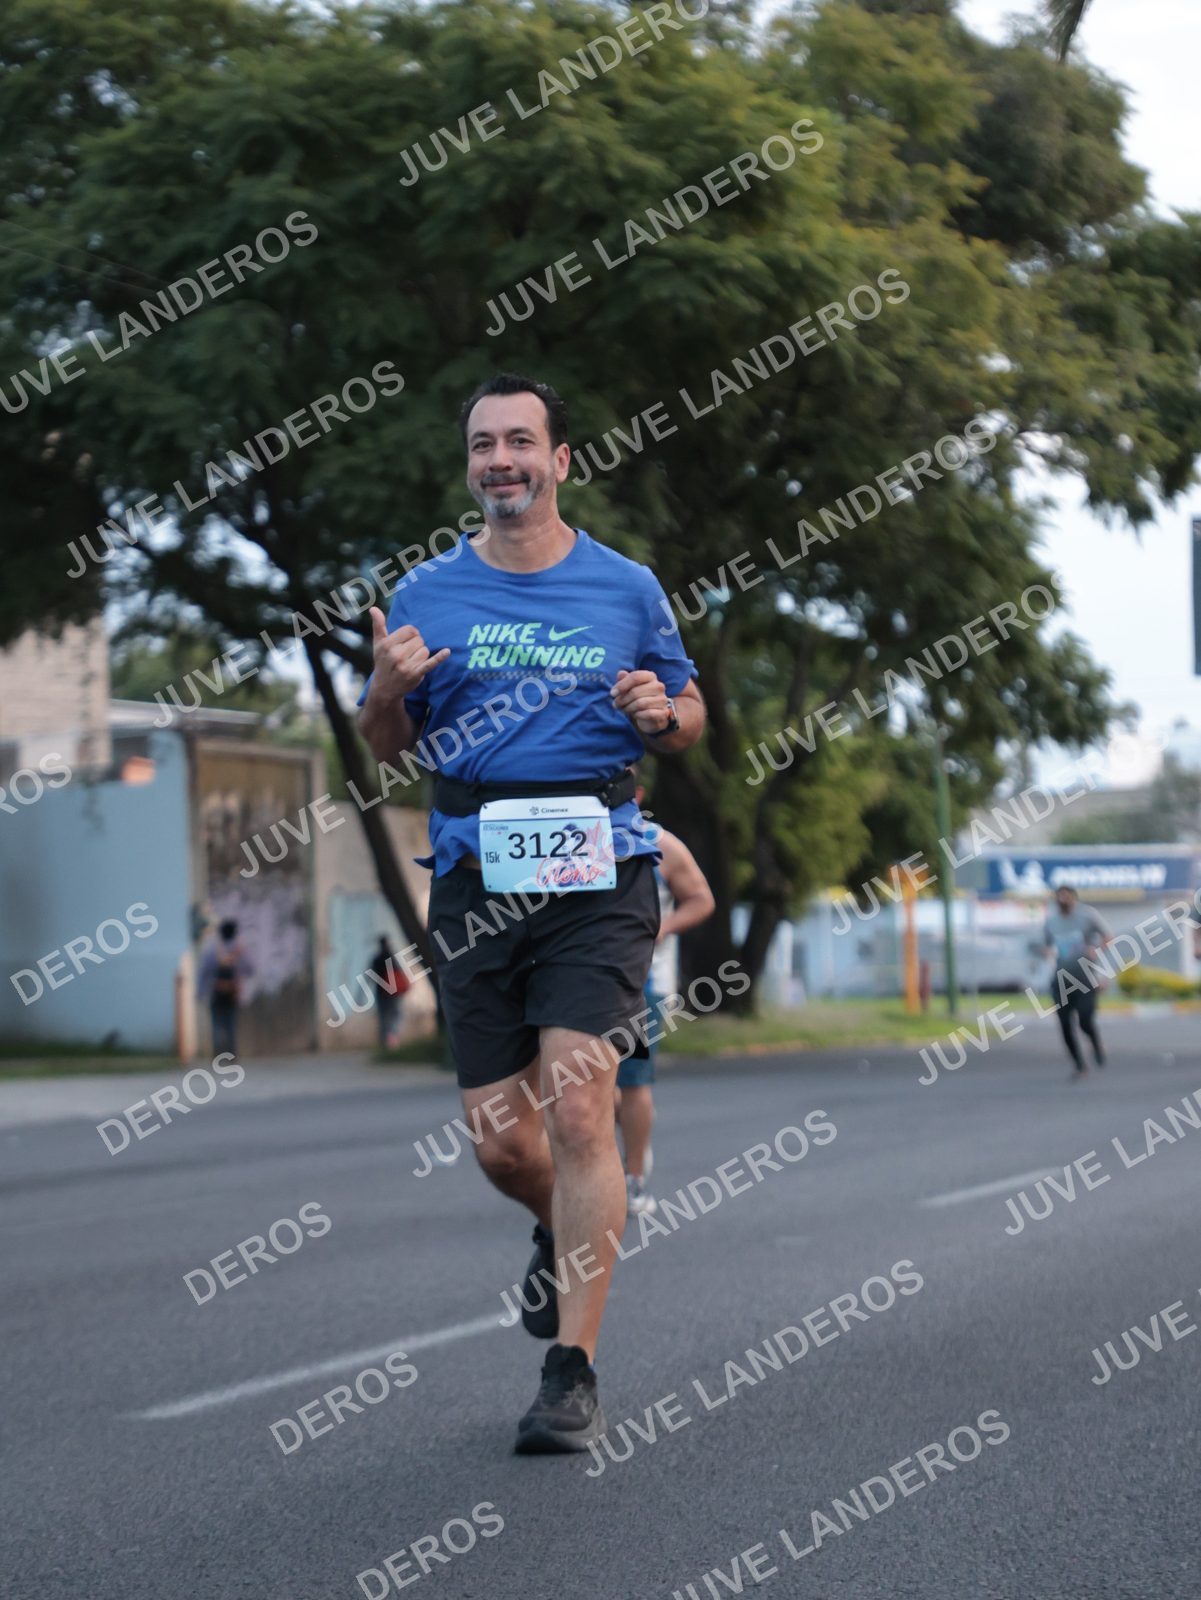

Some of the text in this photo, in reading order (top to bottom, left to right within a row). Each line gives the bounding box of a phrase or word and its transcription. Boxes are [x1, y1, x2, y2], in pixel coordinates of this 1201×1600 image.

[467, 623, 542, 646] NIKE
[467, 644, 606, 669] RUNNING
[508, 830, 588, 860] 3122
